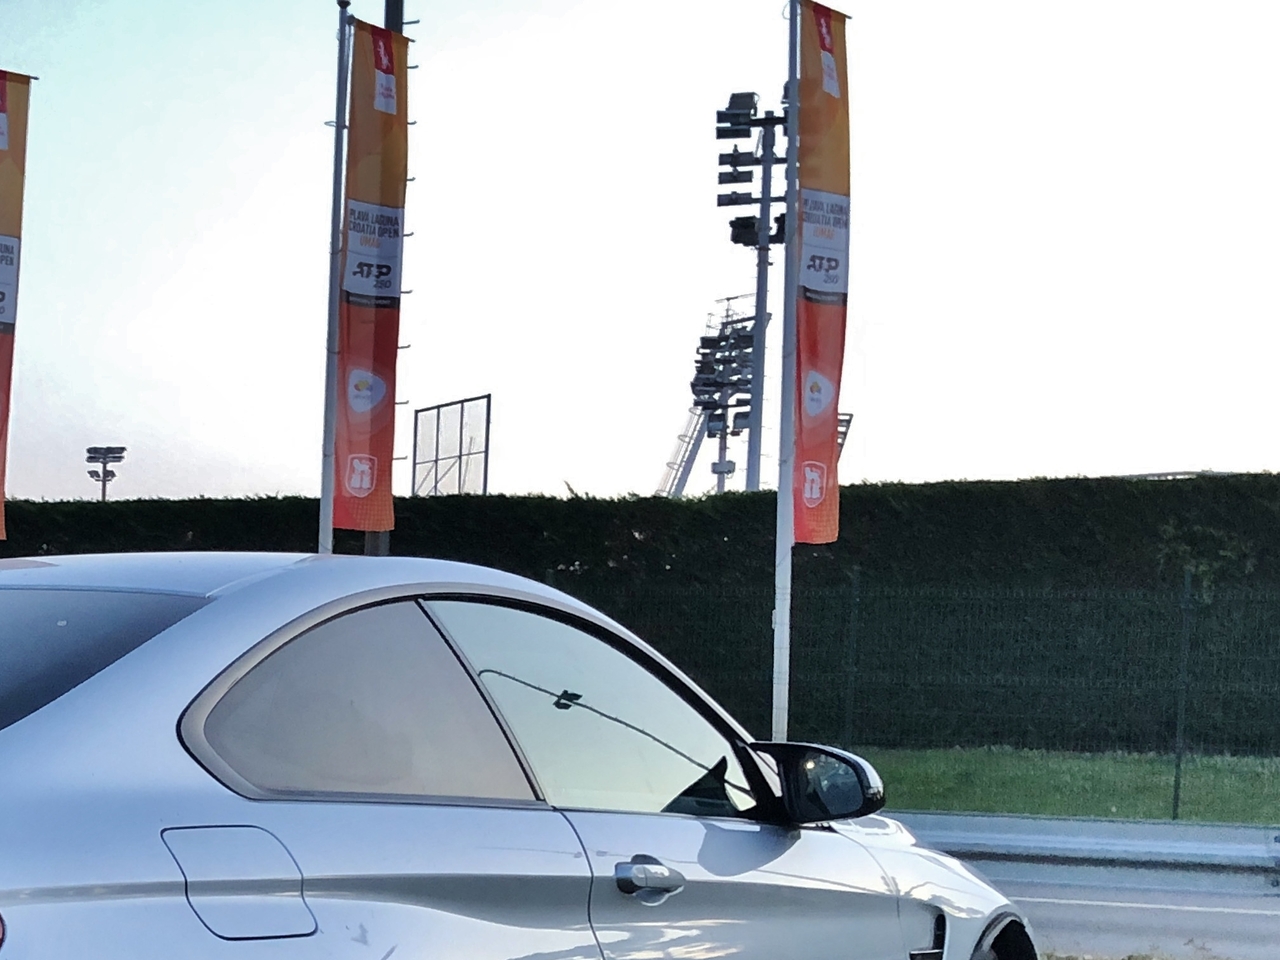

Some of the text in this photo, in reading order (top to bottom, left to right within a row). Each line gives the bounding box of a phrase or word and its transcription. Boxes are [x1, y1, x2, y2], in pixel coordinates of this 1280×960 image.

[350, 208, 399, 226] PLAVA LAGUNA
[349, 221, 399, 238] CROATIA OPEN
[352, 262, 392, 279] ATP
[807, 254, 839, 273] ATP
[373, 280, 392, 289] 250
